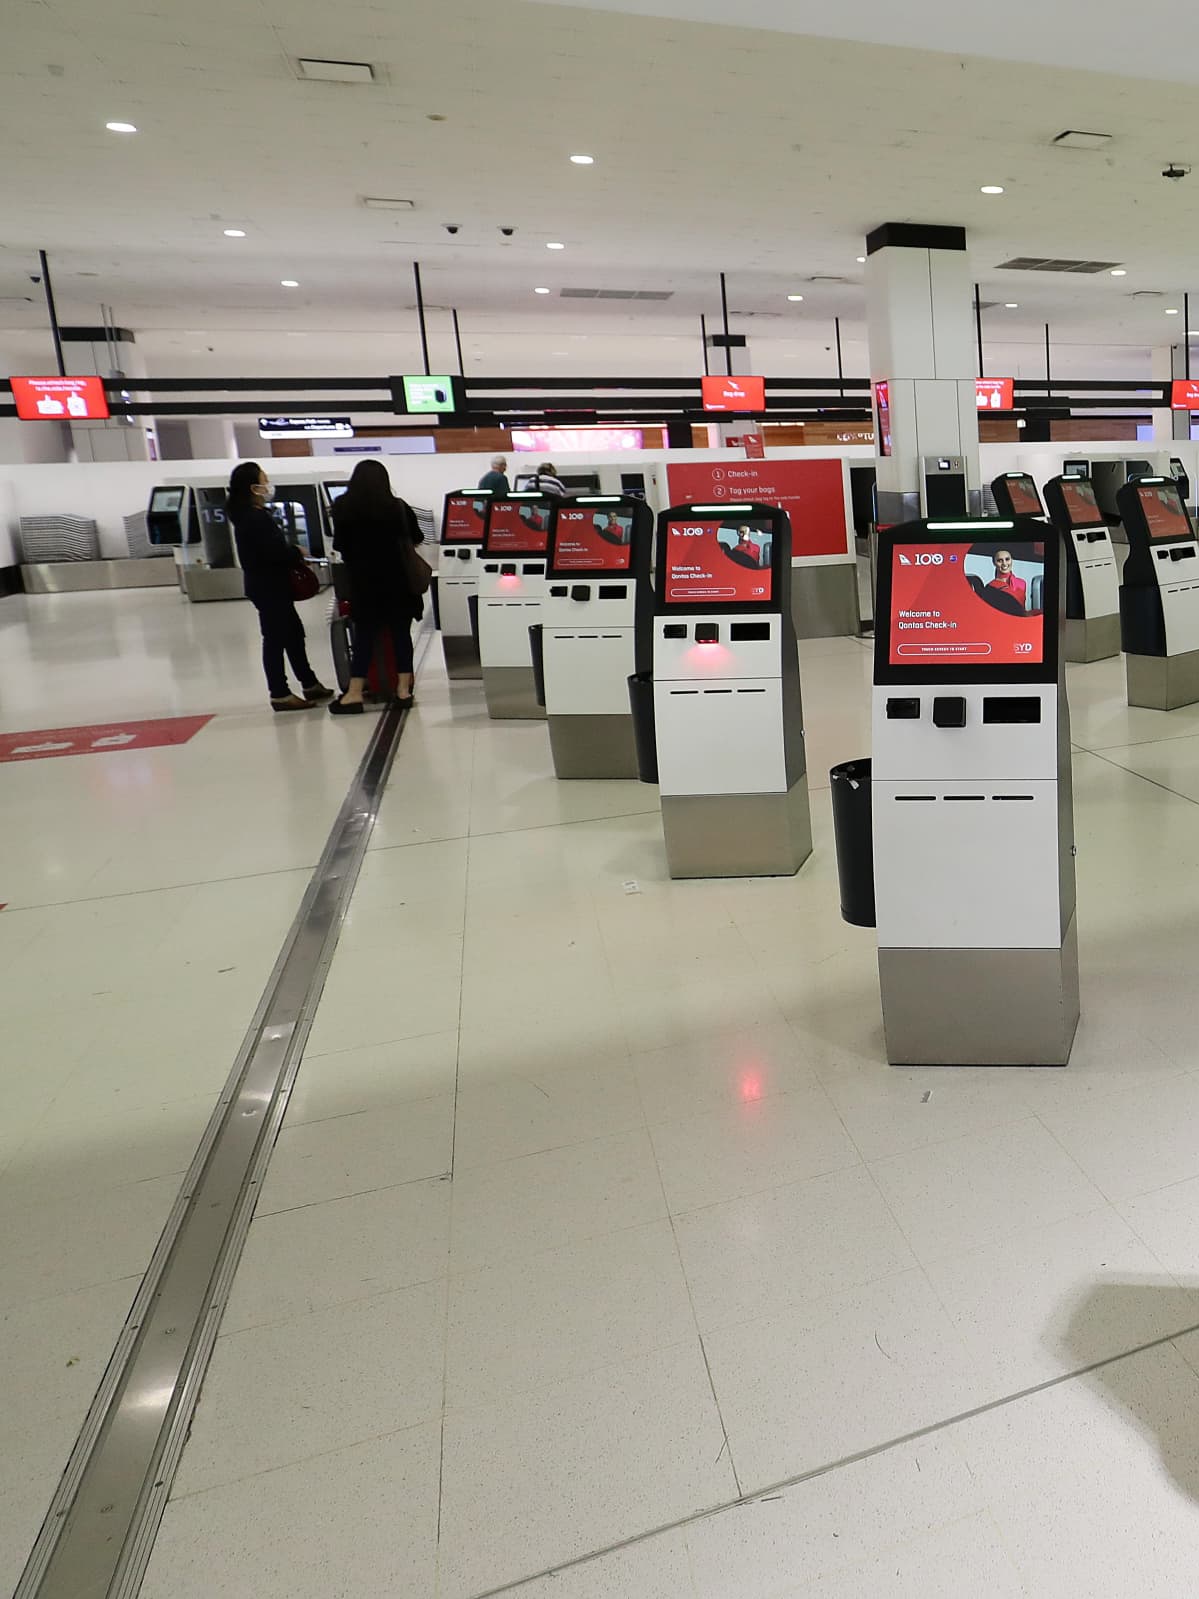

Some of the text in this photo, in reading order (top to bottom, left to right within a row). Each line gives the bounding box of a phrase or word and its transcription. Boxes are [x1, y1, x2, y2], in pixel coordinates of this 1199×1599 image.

[759, 486, 775, 494] bags
[203, 509, 224, 523] 15
[683, 528, 703, 536] 100
[914, 554, 944, 566] 100
